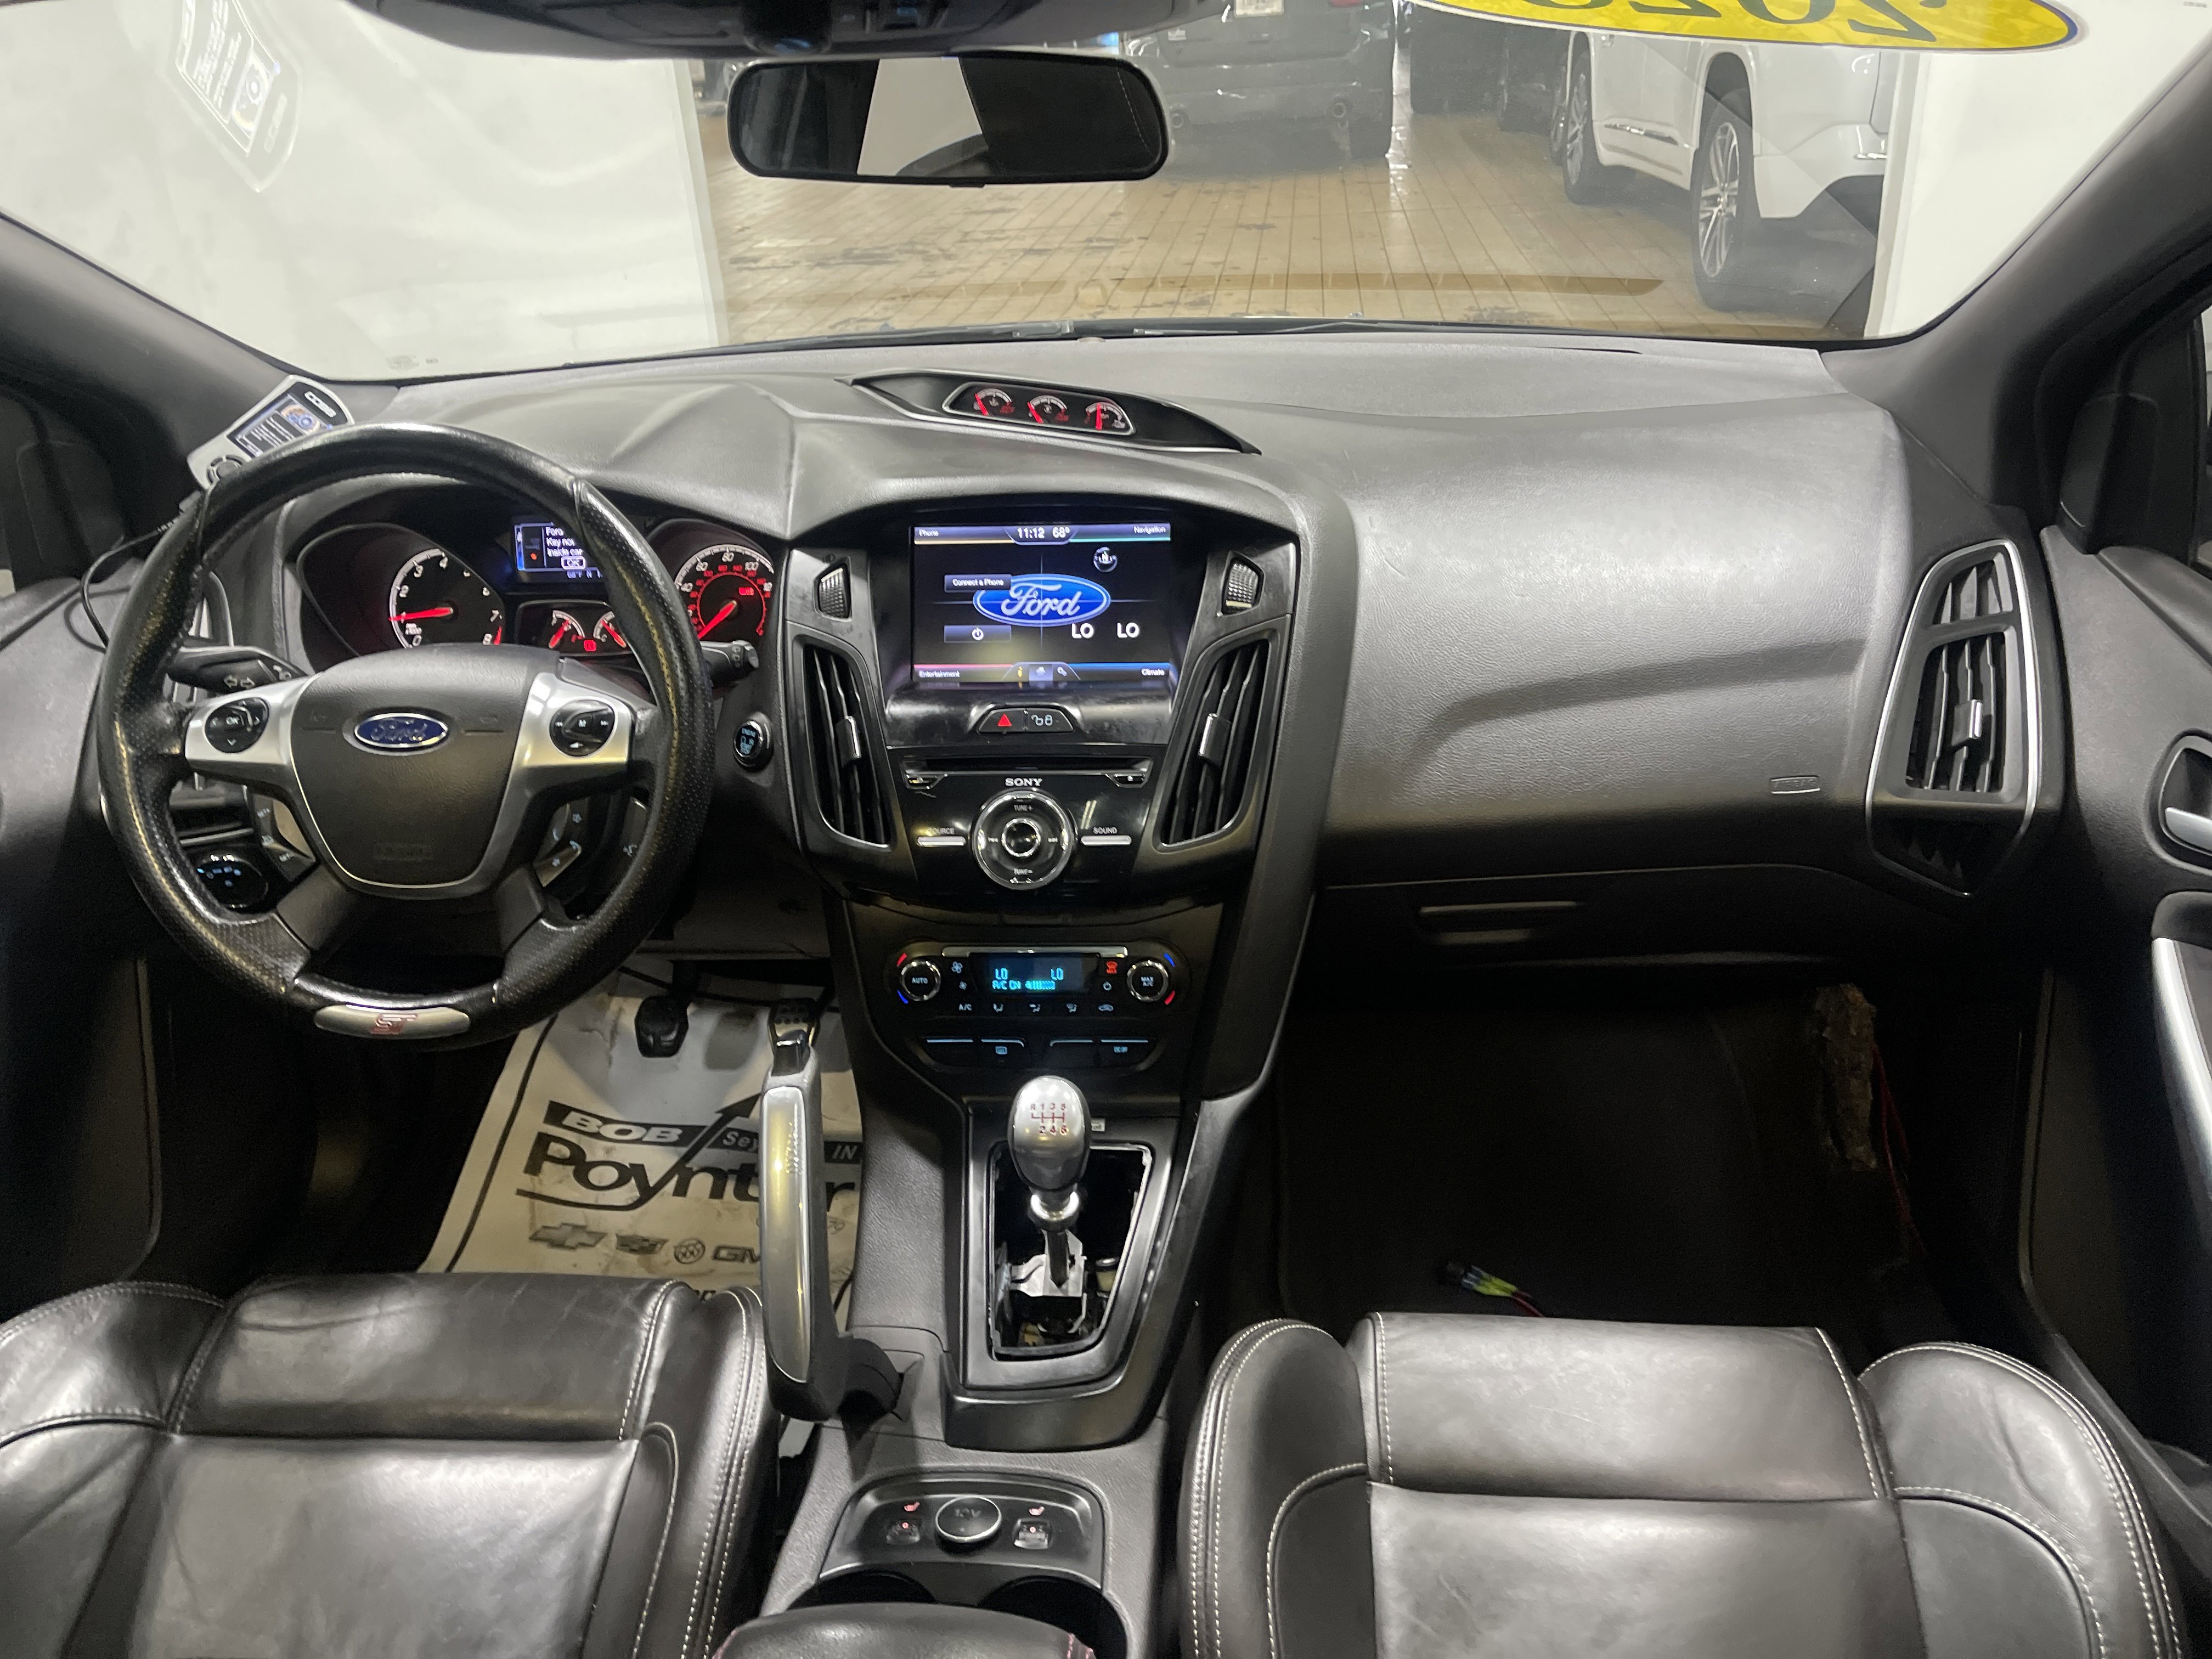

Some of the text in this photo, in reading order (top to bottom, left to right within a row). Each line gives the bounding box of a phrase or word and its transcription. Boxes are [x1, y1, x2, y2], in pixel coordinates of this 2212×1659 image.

[918, 528, 939, 537] Phone
[1017, 527, 1045, 538] 11:12
[1133, 525, 1166, 534] Navigation
[414, 565, 424, 578] 3
[952, 578, 977, 586] Connect
[984, 578, 1004, 586] Phone
[1000, 582, 1083, 616] Ford
[490, 610, 499, 622] 7
[1071, 623, 1094, 639] LO
[1117, 622, 1140, 638] LO
[919, 670, 960, 678] Entertainment
[1141, 668, 1165, 676] Climate
[226, 716, 239, 725] OK
[370, 717, 428, 741] Ford
[1005, 777, 1043, 787] SONY
[1774, 779, 1817, 789] ARBAG
[995, 967, 1063, 980] LO LO
[370, 1013, 417, 1035] ST
[561, 1110, 682, 1143] BOB
[832, 1144, 858, 1160] IN
[521, 1131, 856, 1212] Poyntr
[712, 1244, 761, 1264] GM
